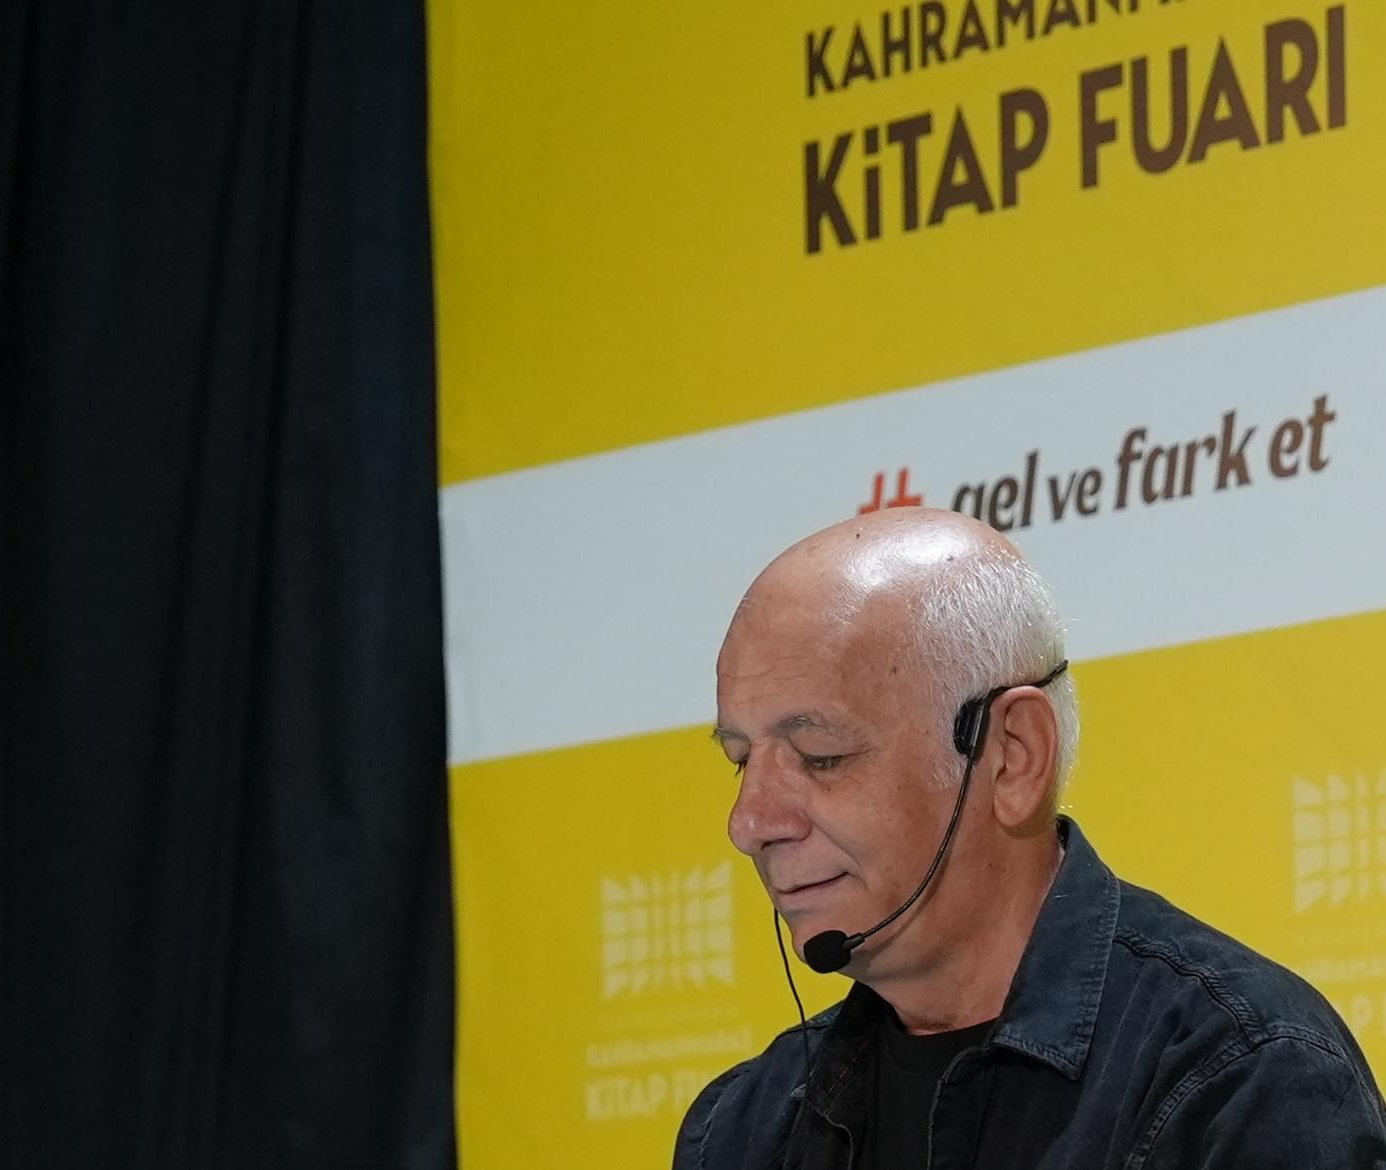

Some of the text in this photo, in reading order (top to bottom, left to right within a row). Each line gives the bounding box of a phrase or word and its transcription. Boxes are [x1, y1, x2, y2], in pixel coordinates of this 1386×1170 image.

[1080, 5, 1347, 190] FUARI
[1049, 466, 1102, 523] ve
[1114, 409, 1258, 512] fark
[1268, 394, 1336, 479] et
